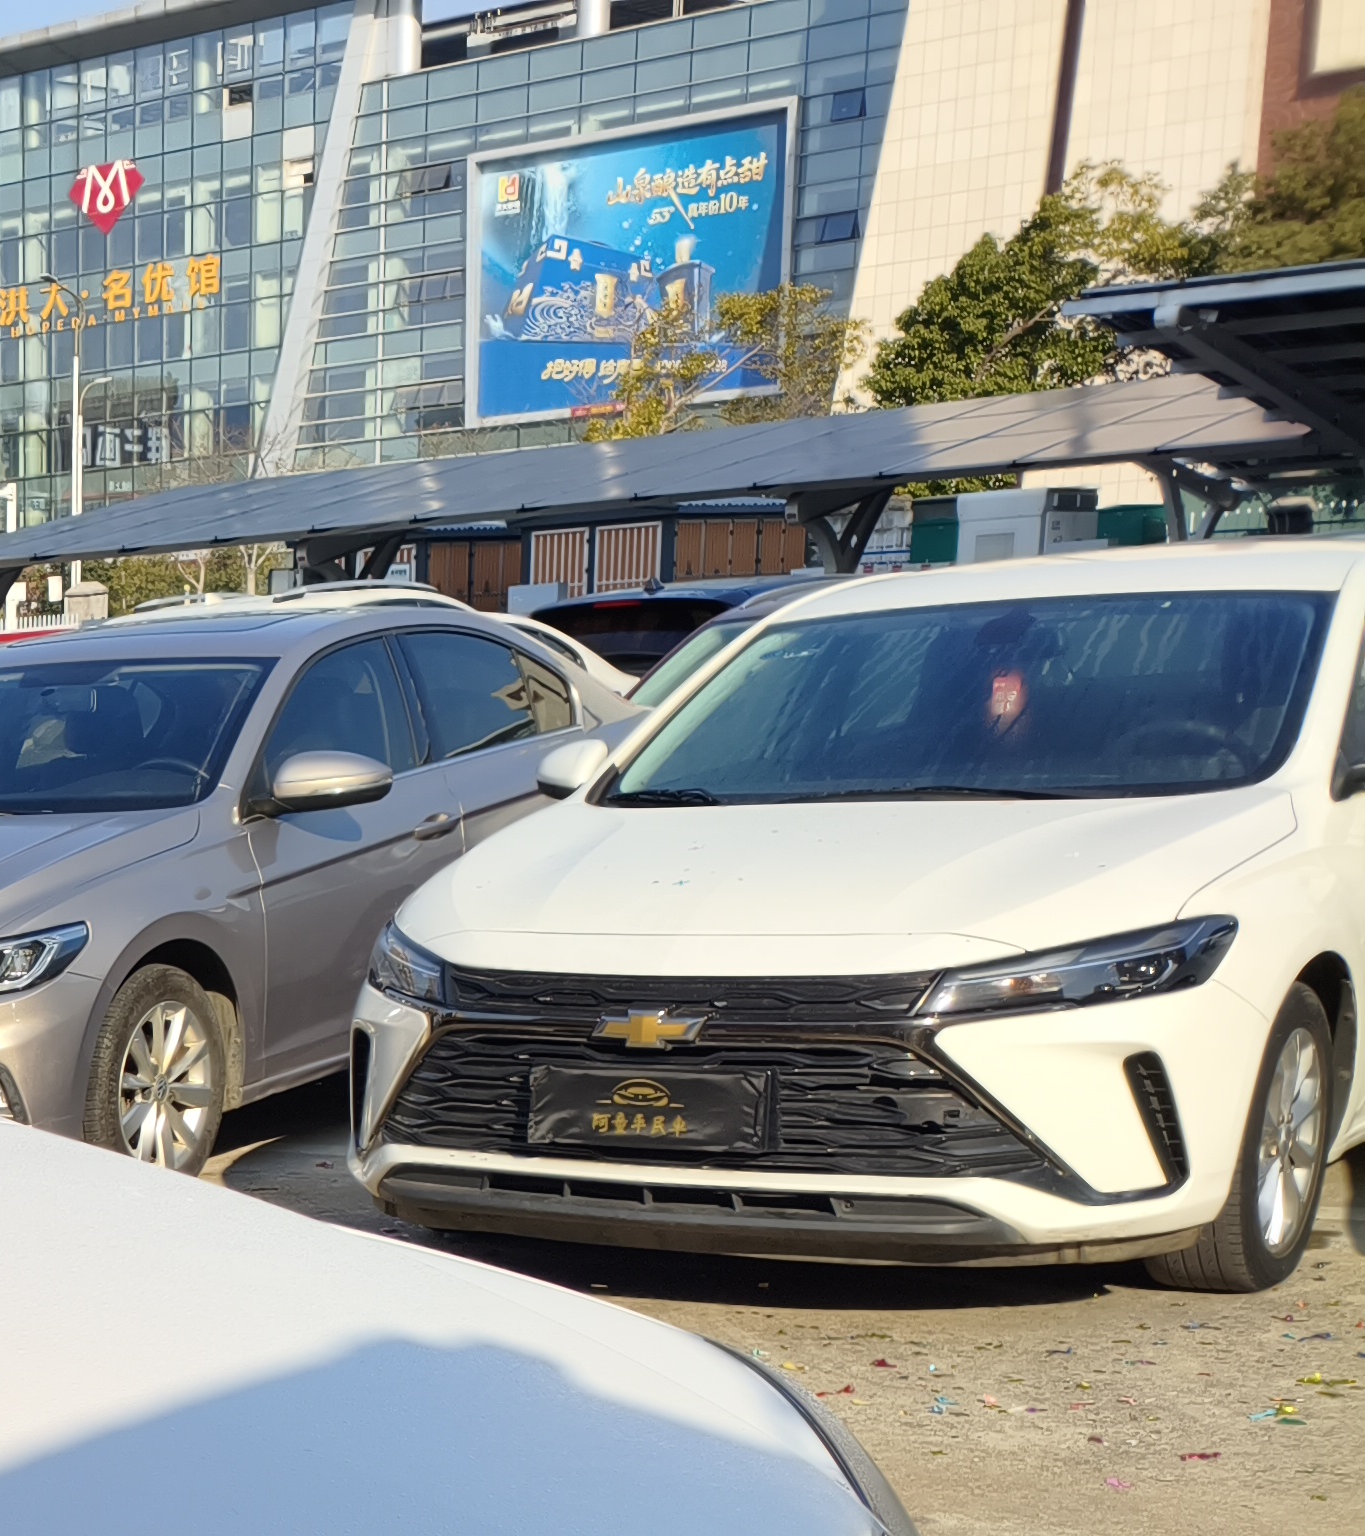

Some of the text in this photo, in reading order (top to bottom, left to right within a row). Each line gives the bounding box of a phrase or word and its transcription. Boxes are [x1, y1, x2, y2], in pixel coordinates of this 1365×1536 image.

[606, 152, 768, 205] 山泉酿造有点甜
